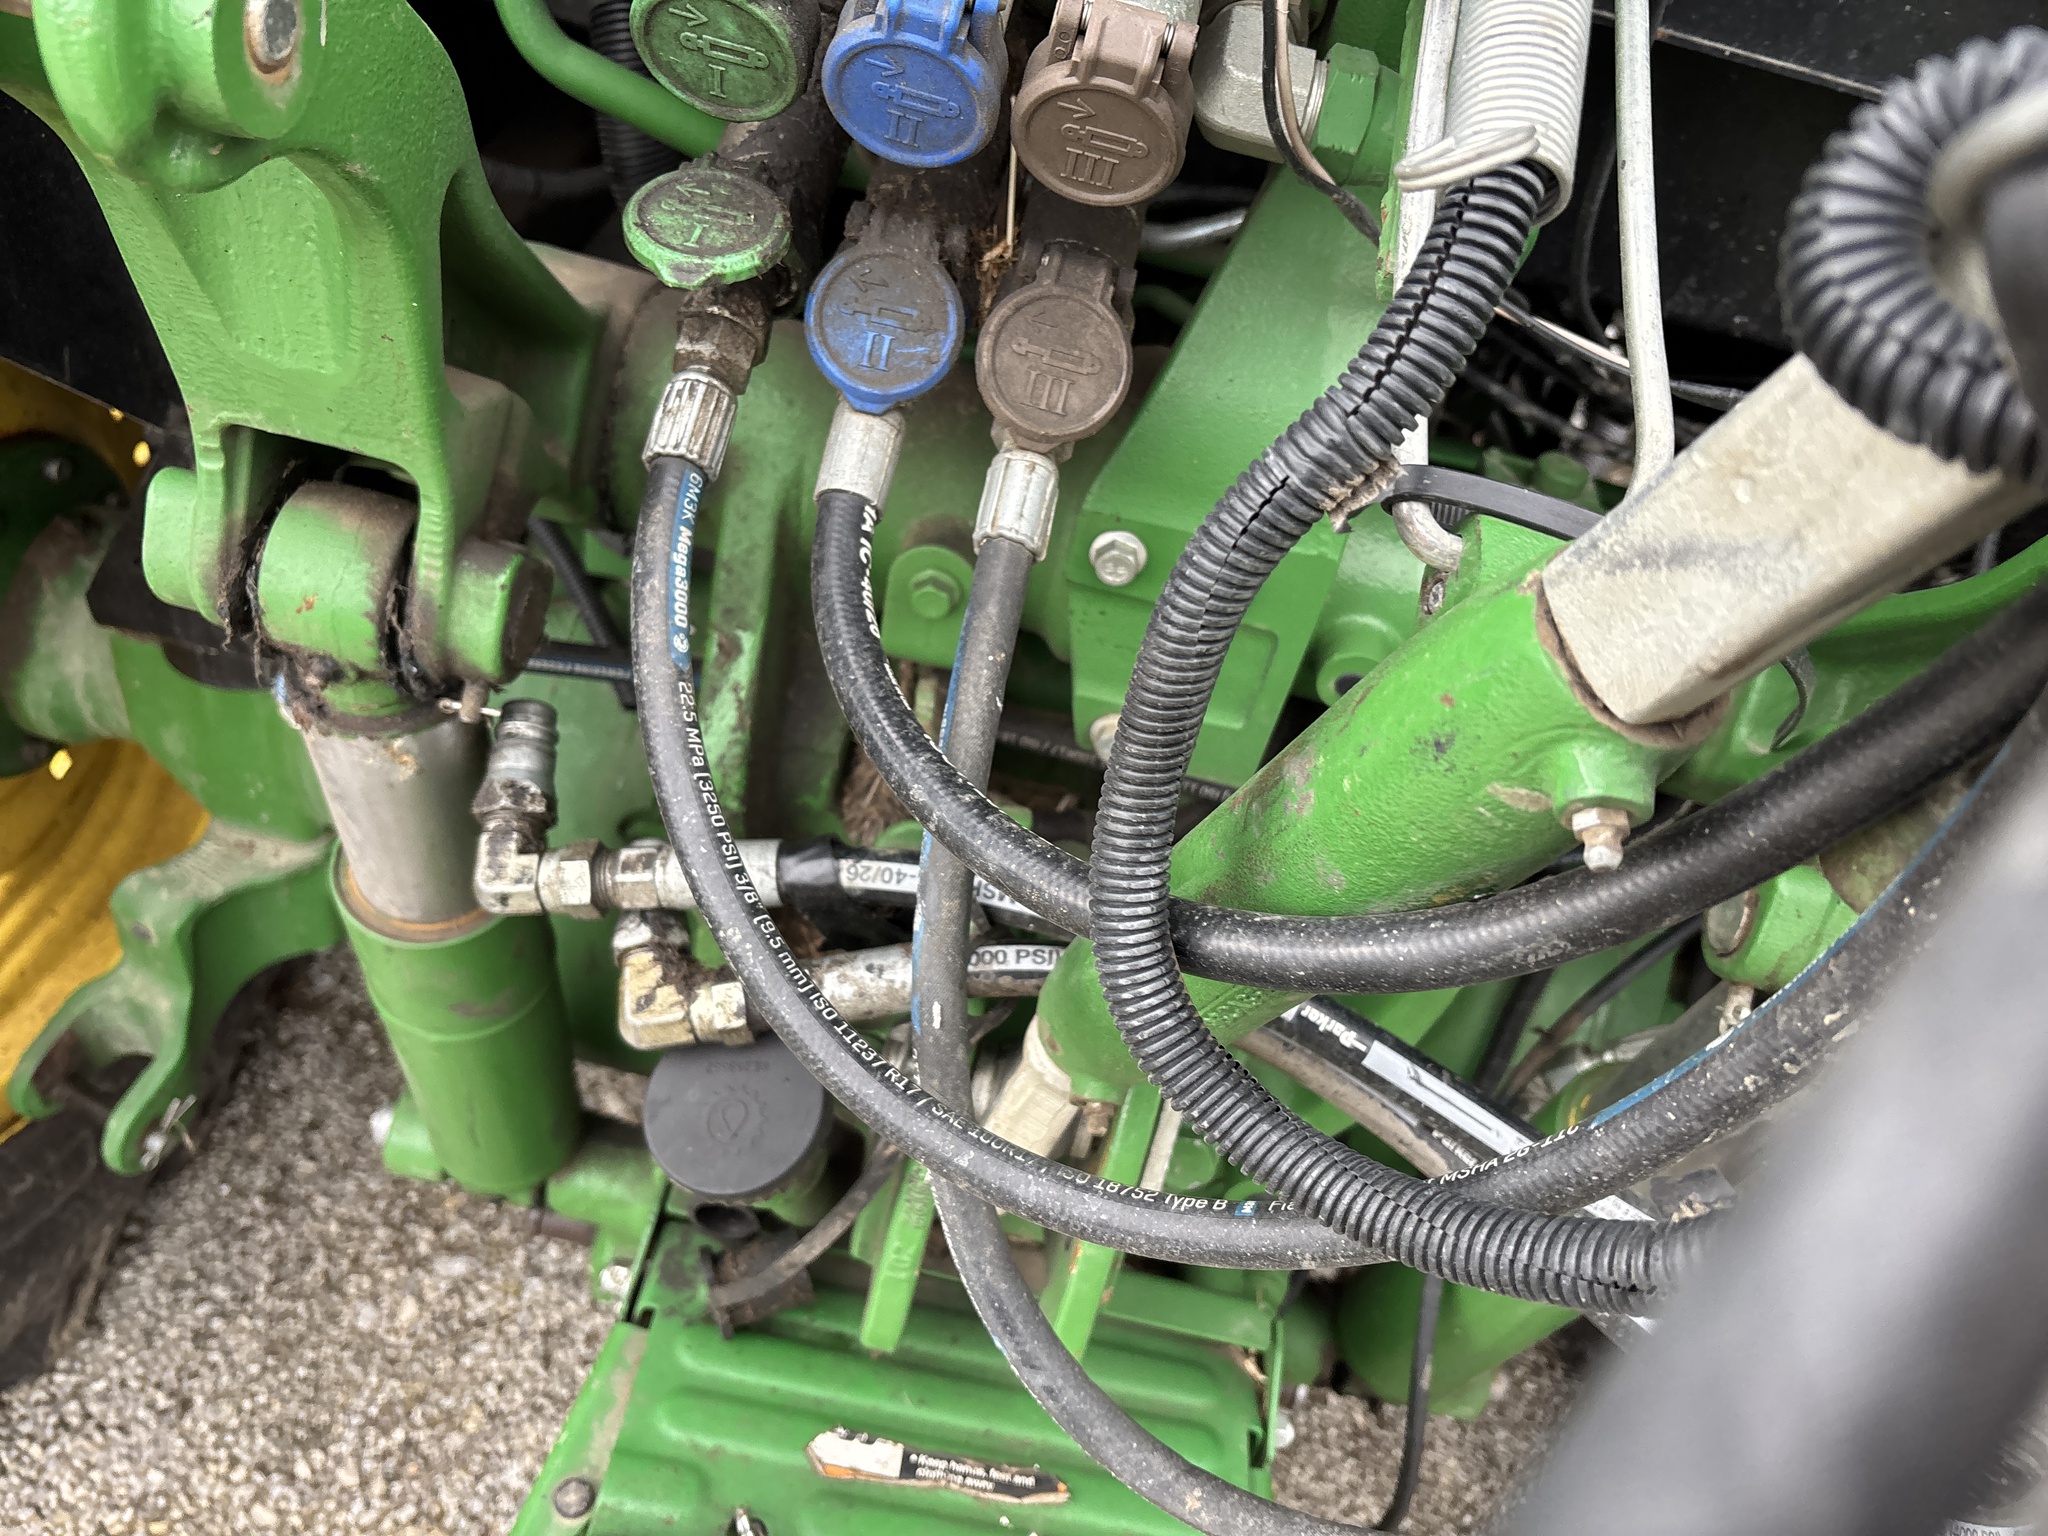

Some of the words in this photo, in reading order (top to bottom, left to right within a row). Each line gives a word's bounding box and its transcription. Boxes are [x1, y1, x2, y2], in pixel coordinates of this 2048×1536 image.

[883, 109, 922, 148] II
[1060, 147, 1119, 189] III
[858, 330, 895, 372] II
[1020, 370, 1075, 416] III
[682, 472, 704, 525] 6M3K
[673, 525, 693, 629] Mega3000
[678, 681, 698, 722] 22.5
[685, 728, 706, 767] MPa
[693, 773, 725, 827] (3250
[716, 832, 743, 870] PSI)
[778, 951, 815, 994] mm)
[808, 992, 838, 1020] ISO
[833, 1020, 887, 1067] 11237
[1300, 1005, 1358, 1049] Parker
[884, 1067, 922, 1096] R17
[931, 1102, 968, 1129] SAE
[1440, 1157, 1498, 1184] MSHA
[1164, 1192, 1209, 1213] Type
[1212, 1199, 1228, 1211] B
